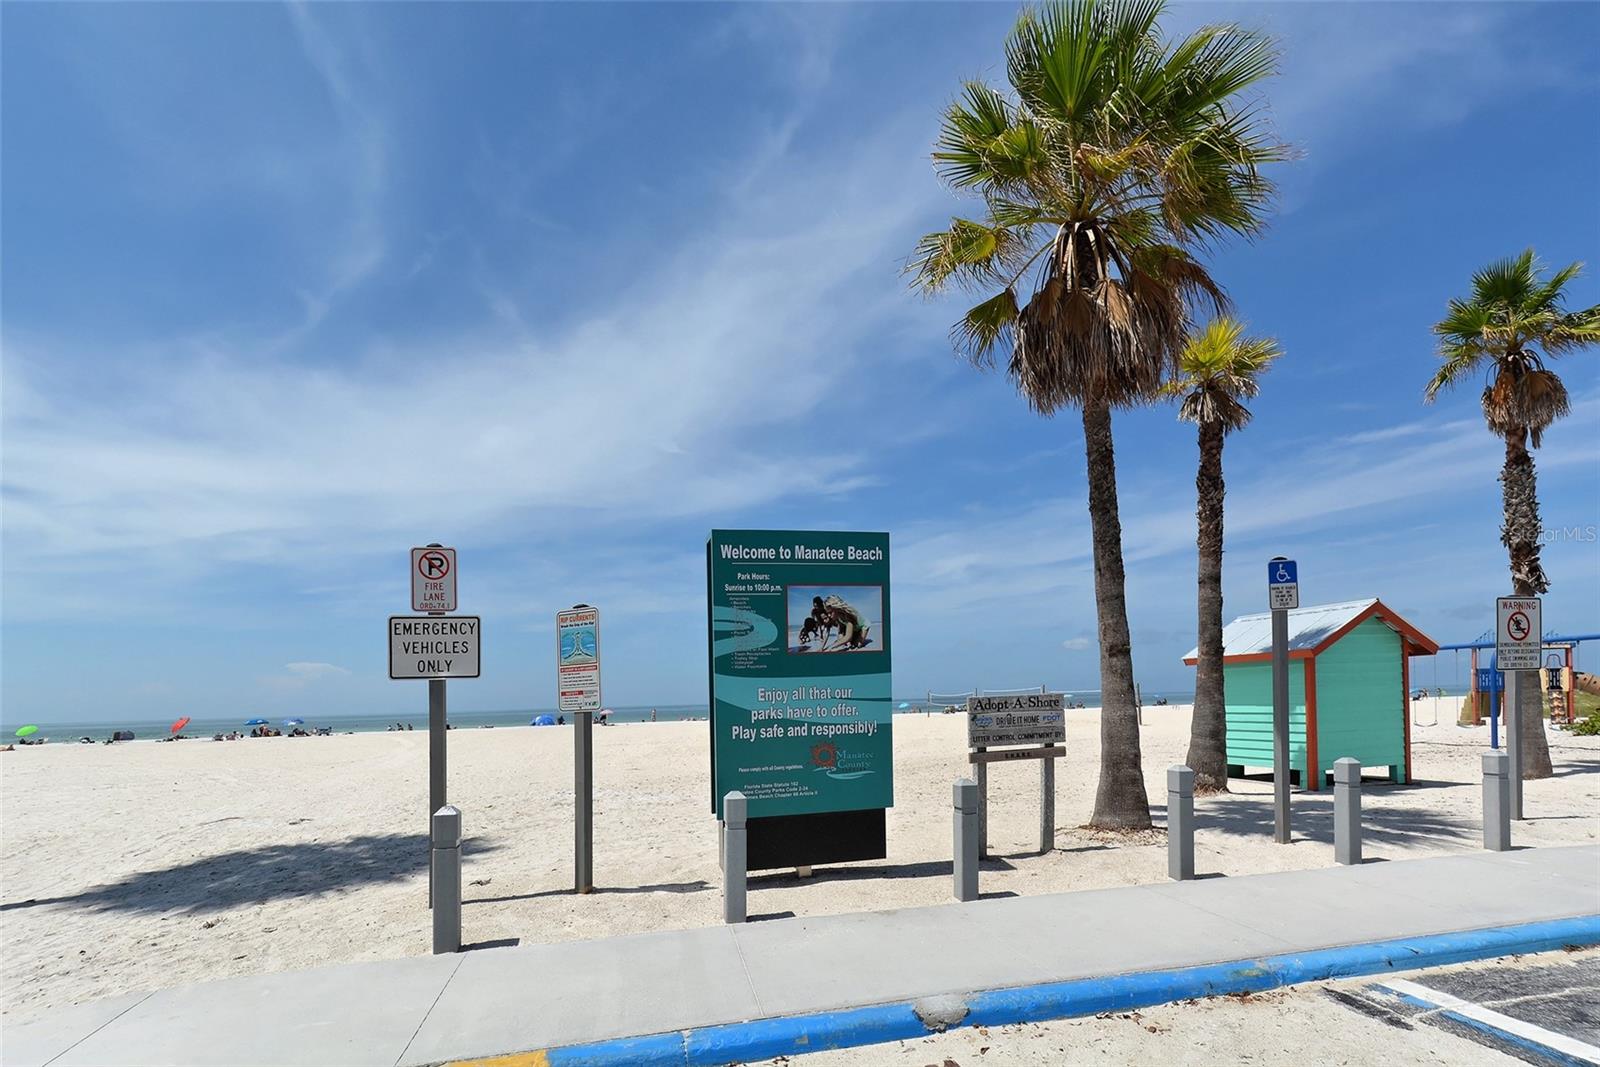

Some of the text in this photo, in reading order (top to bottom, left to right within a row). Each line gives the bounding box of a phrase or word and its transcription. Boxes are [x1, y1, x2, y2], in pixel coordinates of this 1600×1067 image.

[720, 544, 883, 560] Welcome to Manatee Beach
[425, 582, 444, 590] FIRE
[424, 592, 445, 600] LANE
[1502, 601, 1536, 610] WARNING
[394, 622, 476, 635] EMERGENCY
[403, 641, 469, 654] VEHICLES
[417, 660, 453, 673] ONLY
[758, 687, 853, 704] Enjoy all that our
[751, 704, 859, 723] parks have to offer.
[1024, 715, 1039, 724] HOME
[732, 720, 878, 742] Play safe and responsibly!
[836, 751, 873, 759] Manatee
[838, 760, 872, 768] County
